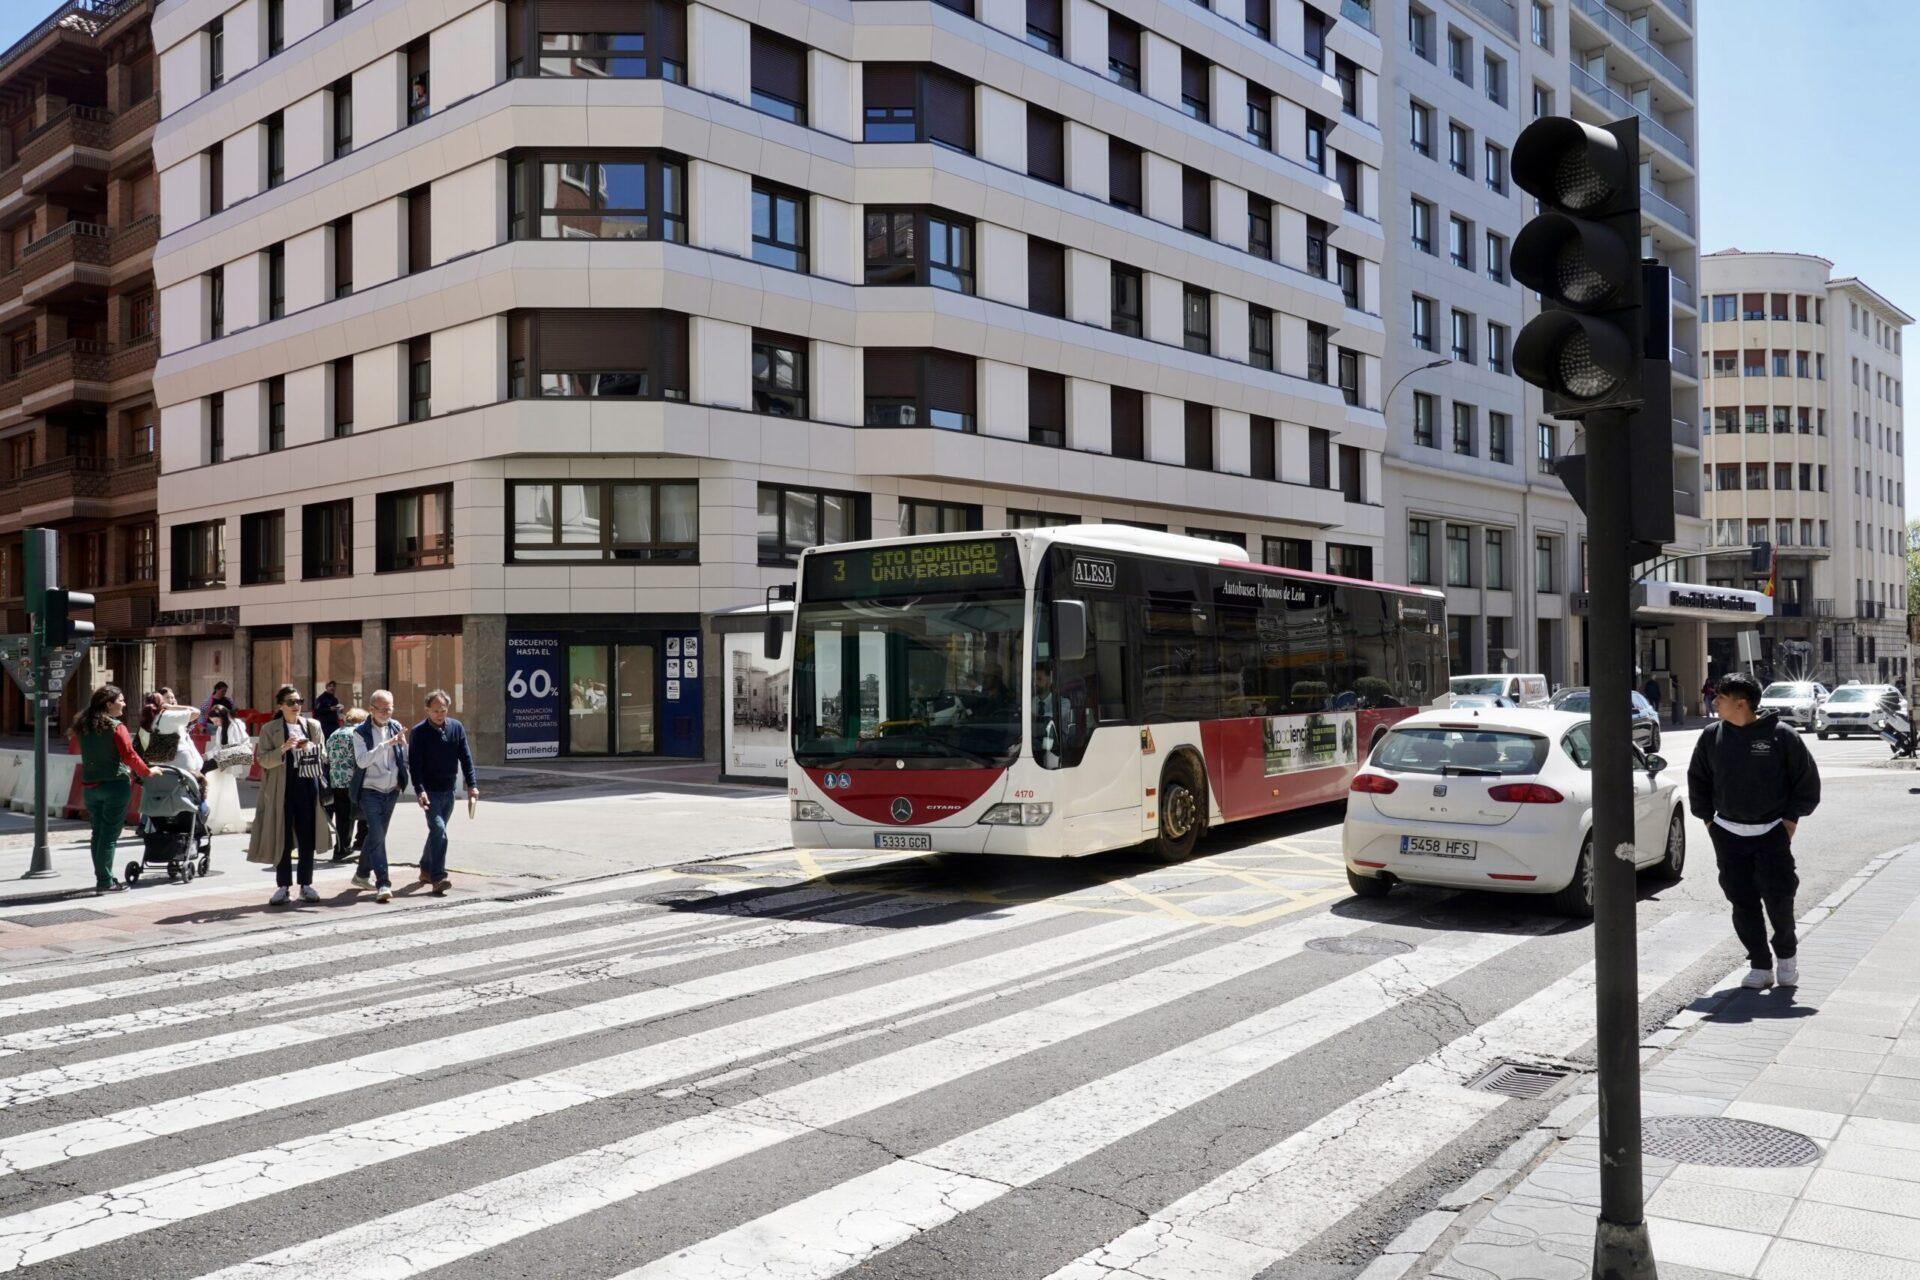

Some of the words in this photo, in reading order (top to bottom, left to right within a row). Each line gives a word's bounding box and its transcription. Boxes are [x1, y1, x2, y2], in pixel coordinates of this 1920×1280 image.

[873, 551, 905, 566] STO
[911, 544, 996, 564] DOMINGO
[832, 560, 846, 582] 3
[872, 558, 998, 582] UNIVERSIDAD
[1075, 562, 1112, 584] ALESA
[1222, 580, 1256, 597] Autobuses
[1257, 584, 1282, 600] Urbanos
[1283, 586, 1290, 600] de
[1291, 587, 1306, 602] León
[1014, 790, 1034, 798] 4170
[882, 836, 906, 848] 5333
[908, 837, 928, 848] GCR
[1410, 838, 1440, 852] 5458
[1446, 842, 1470, 854] HFS
